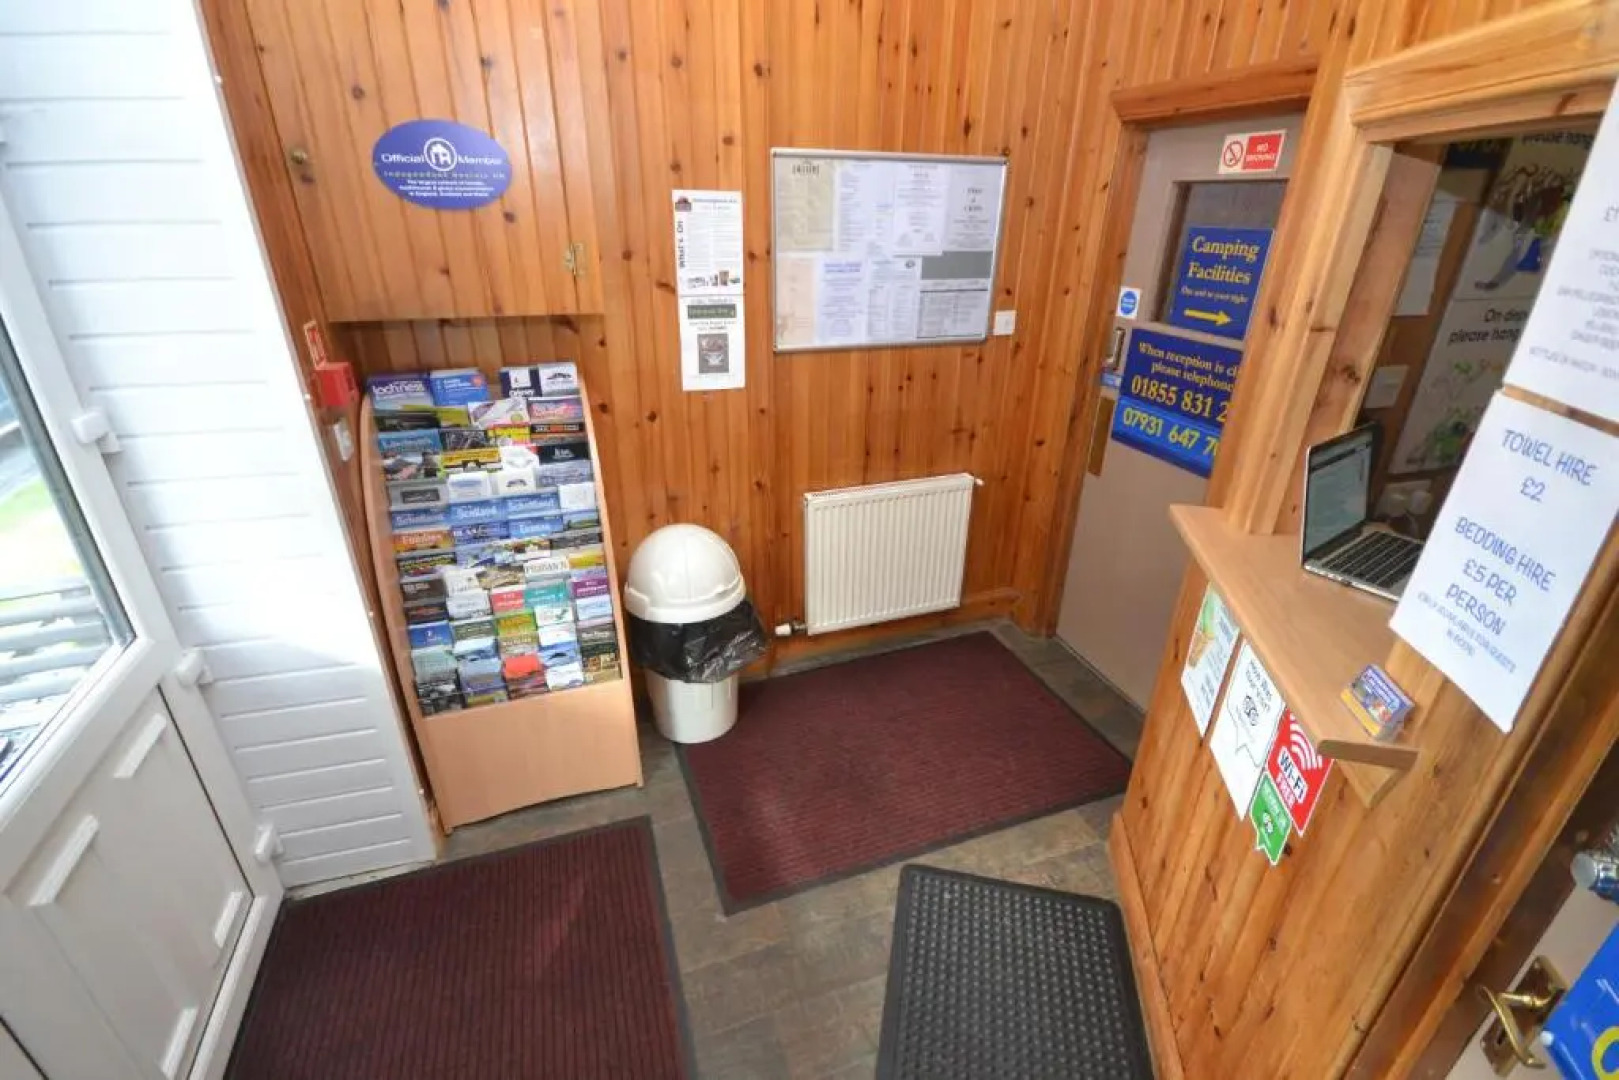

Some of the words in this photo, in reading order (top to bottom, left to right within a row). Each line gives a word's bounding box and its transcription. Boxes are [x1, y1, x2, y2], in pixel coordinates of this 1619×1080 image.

[381, 153, 424, 164] Official
[456, 154, 502, 165] Member
[1192, 235, 1260, 264] Camping
[1187, 261, 1253, 285] Facilities
[1139, 341, 1165, 358] When
[1166, 350, 1213, 372] reception
[1214, 361, 1225, 375] is
[1151, 360, 1182, 378] please
[1130, 374, 1177, 407] 01855
[1180, 389, 1215, 418] 831
[1122, 406, 1165, 438] 07931
[1167, 424, 1201, 450] 647
[1501, 428, 1554, 469] TOWEL
[1554, 449, 1599, 488] HIRE
[1519, 476, 1546, 505] £2
[1453, 515, 1517, 567] BEDDING
[1516, 553, 1557, 593] HIRE
[1460, 558, 1488, 585] £5
[1484, 573, 1519, 609] PER
[1444, 582, 1506, 637] PERSON
